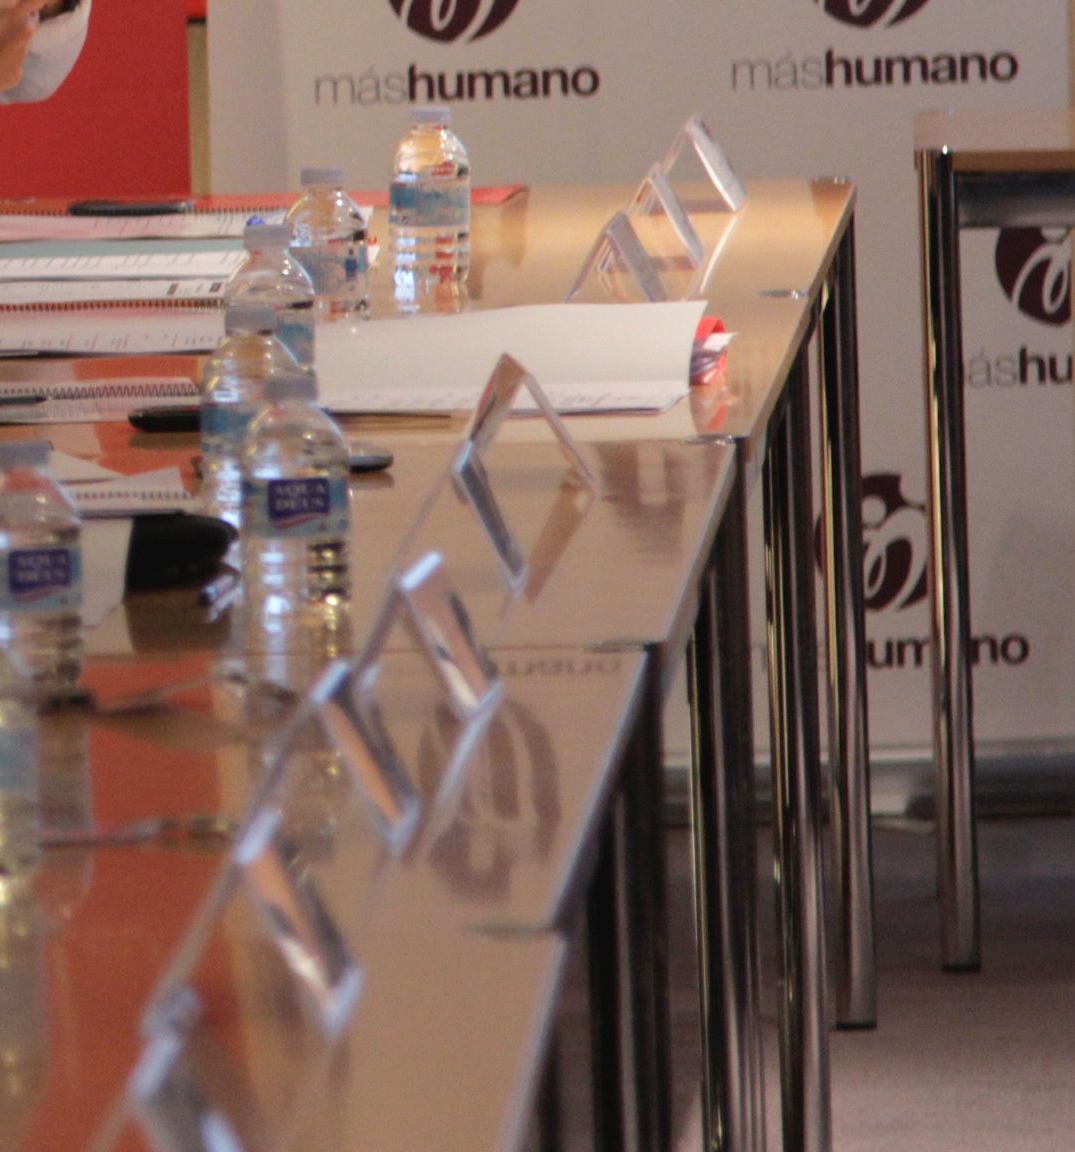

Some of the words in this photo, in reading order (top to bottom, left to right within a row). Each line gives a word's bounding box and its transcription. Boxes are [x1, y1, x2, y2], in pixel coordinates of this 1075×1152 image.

[314, 60, 602, 105] máshumano
[731, 46, 1022, 92] máshumano
[967, 344, 1072, 388] áshu
